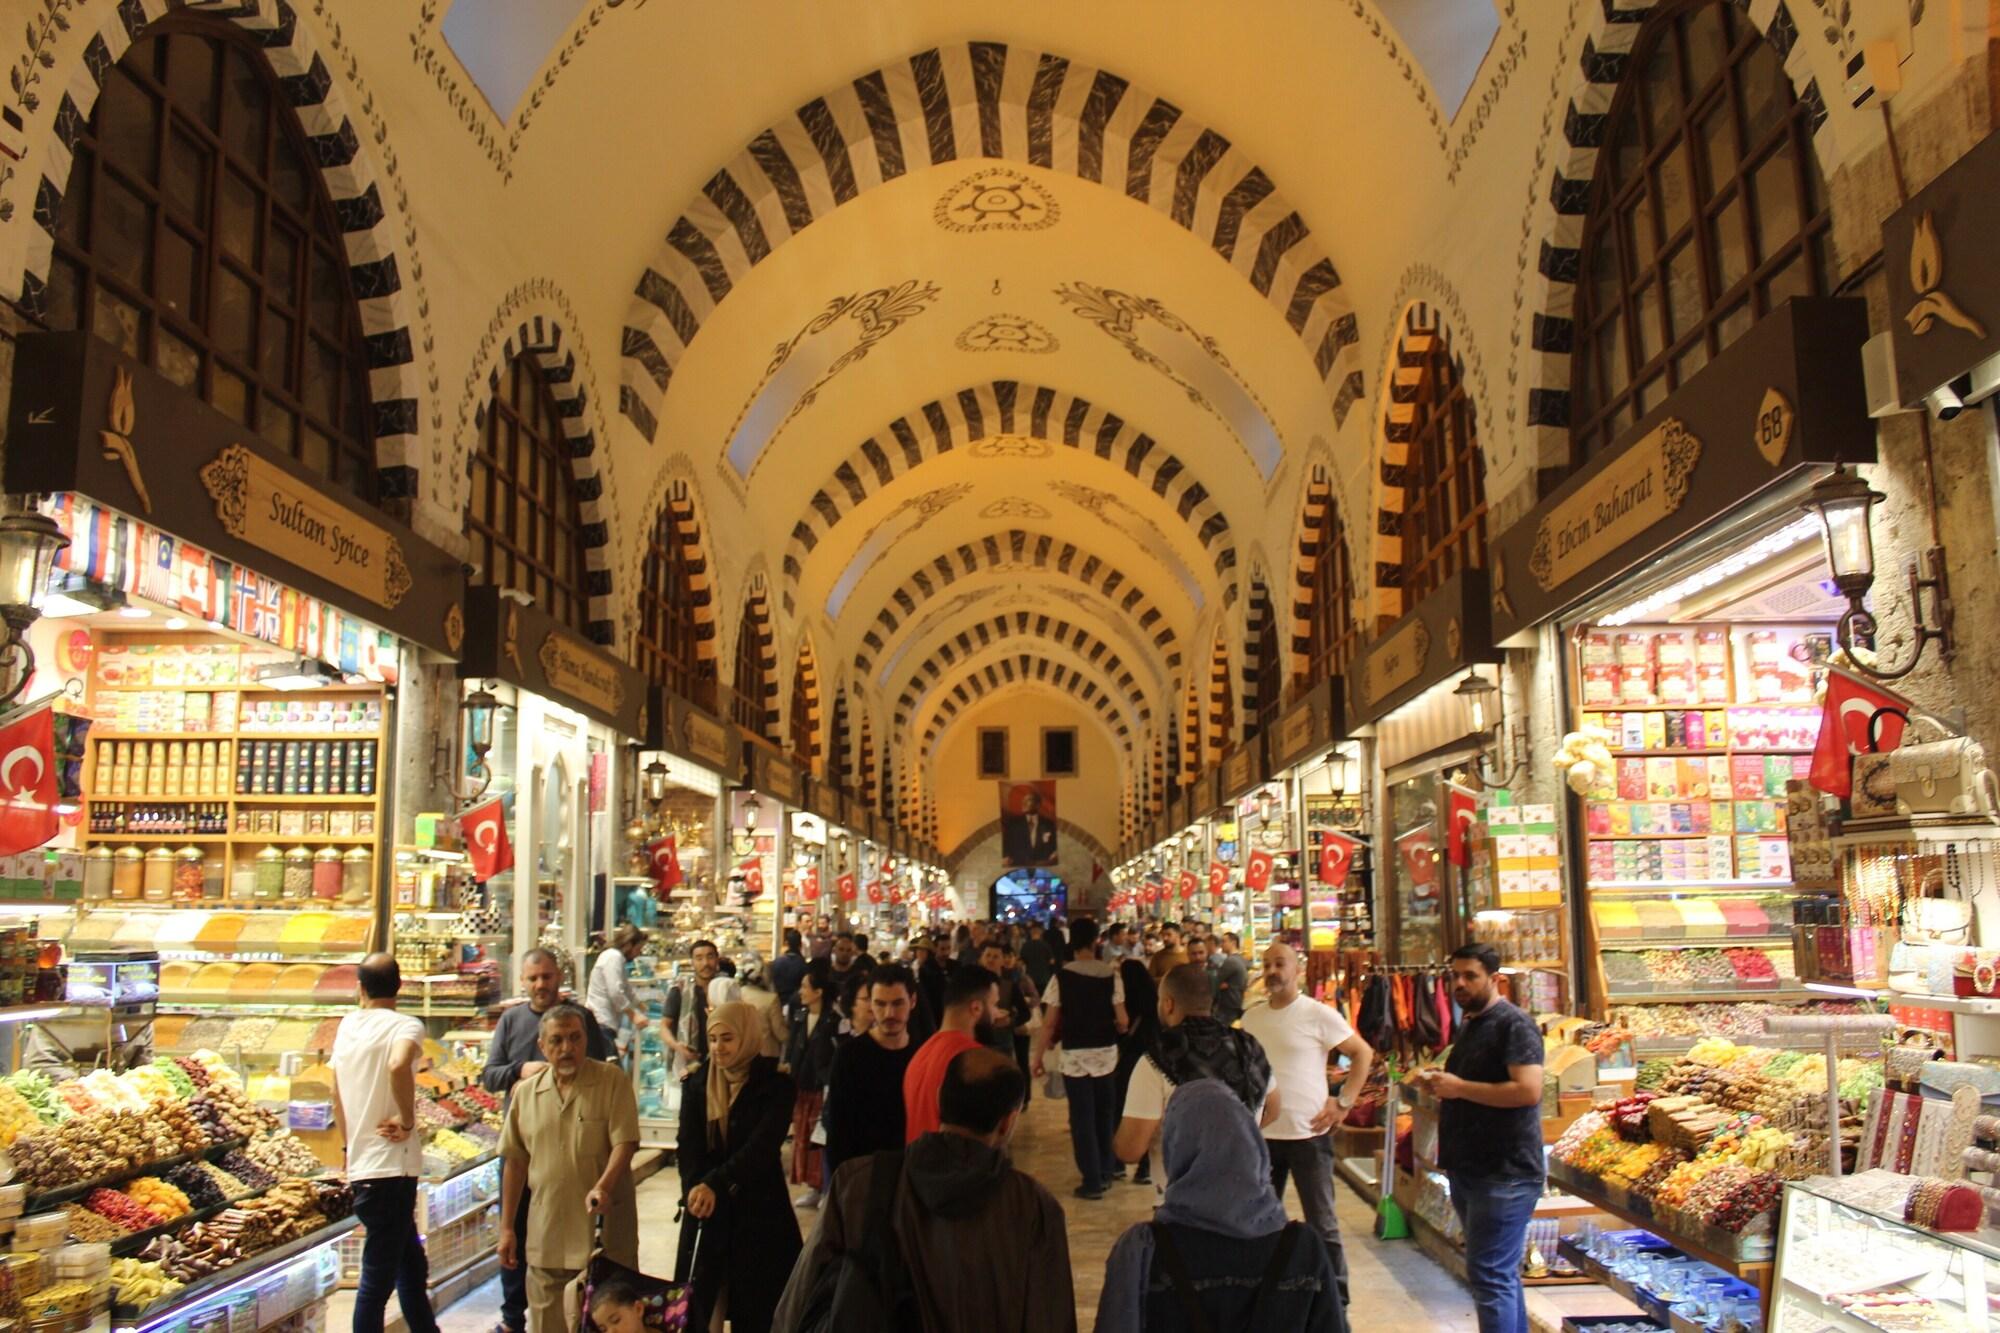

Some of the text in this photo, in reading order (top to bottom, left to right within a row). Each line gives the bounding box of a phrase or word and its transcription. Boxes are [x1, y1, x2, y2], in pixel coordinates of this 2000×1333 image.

[1761, 405, 1782, 446] 68
[269, 491, 370, 568] Sultan Spice
[1594, 468, 1652, 533] Baharat
